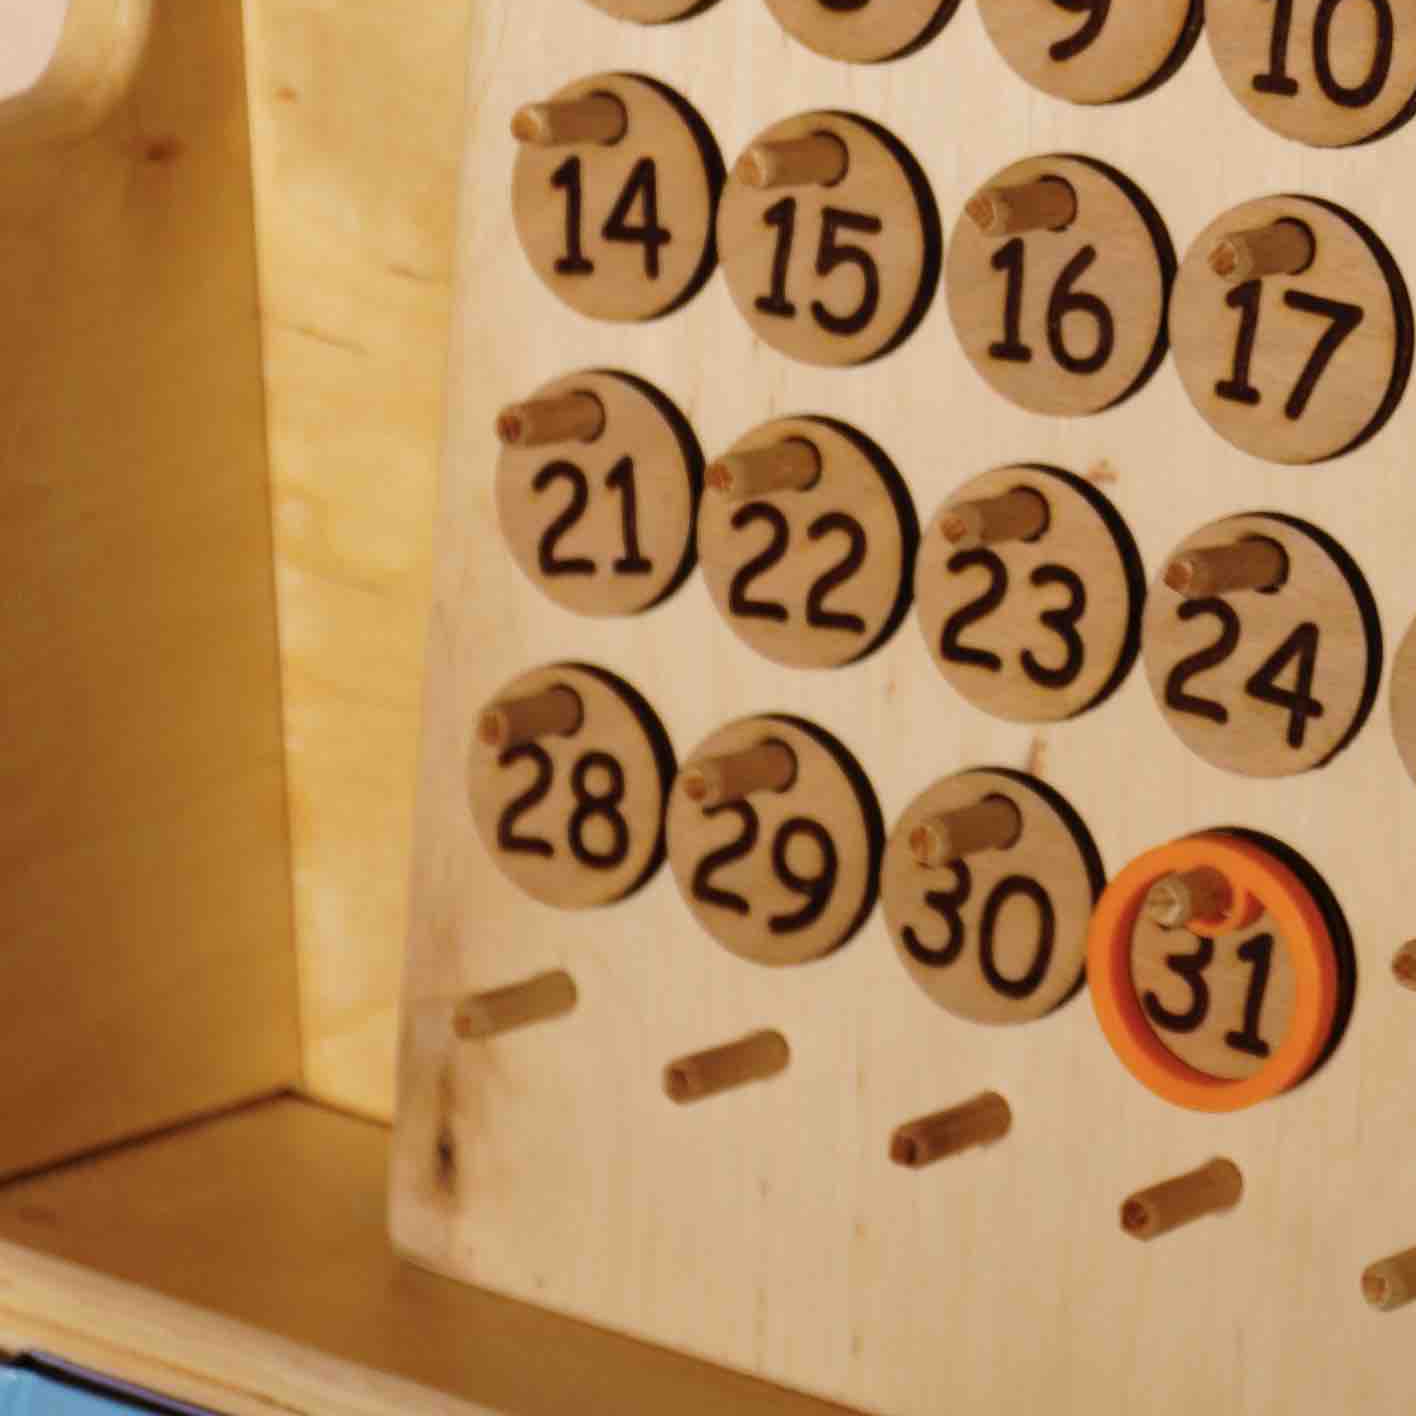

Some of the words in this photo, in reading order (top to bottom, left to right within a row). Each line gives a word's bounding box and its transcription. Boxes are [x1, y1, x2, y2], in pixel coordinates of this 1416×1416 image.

[550, 155, 671, 280] 14
[754, 196, 883, 334] 15
[988, 238, 1114, 374] 16
[1214, 280, 1364, 420] 17
[532, 456, 654, 579] 21
[729, 502, 867, 634] 22
[940, 548, 1086, 689] 23
[1165, 598, 1326, 751] 24
[497, 743, 630, 870] 28
[690, 799, 839, 935] 29
[901, 859, 1055, 1000] 30
[1143, 932, 1274, 1059] 31
